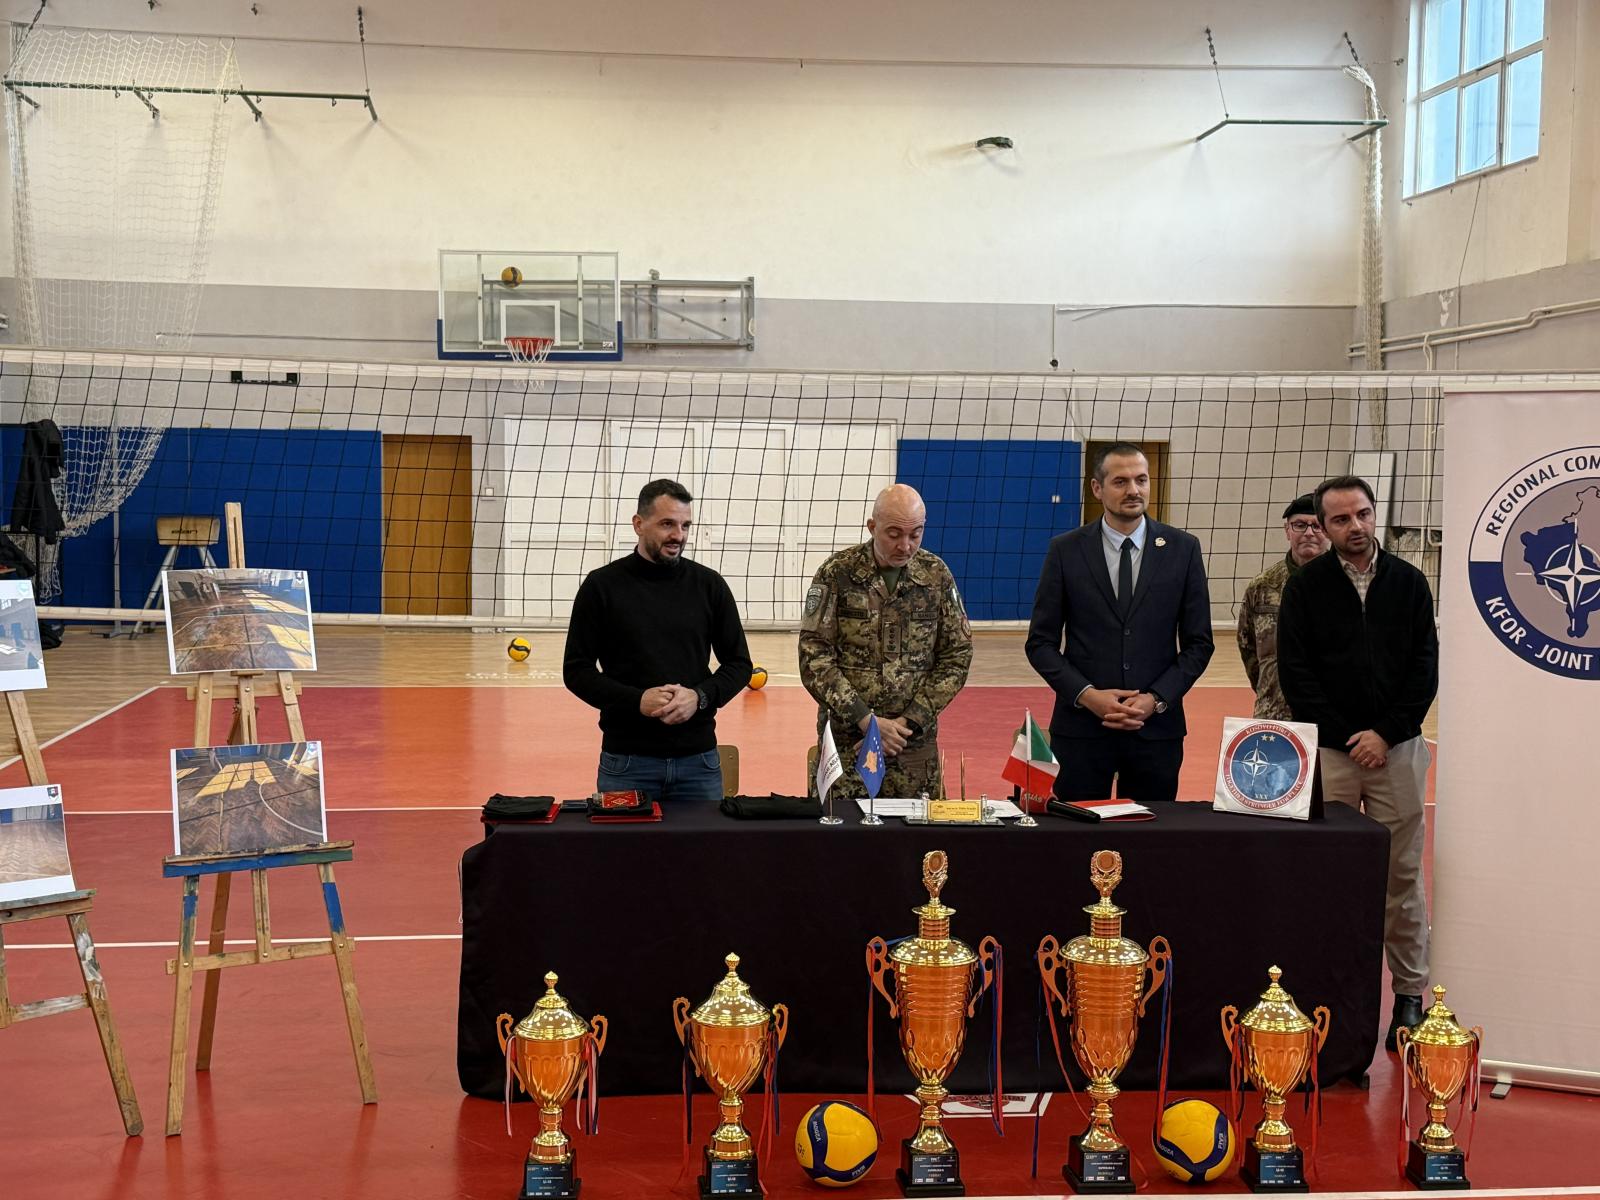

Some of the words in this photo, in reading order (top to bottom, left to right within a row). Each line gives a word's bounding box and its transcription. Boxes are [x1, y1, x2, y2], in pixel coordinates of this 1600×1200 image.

[1485, 463, 1559, 537] REGIONAL
[1485, 596, 1527, 645] KFOR
[1534, 644, 1594, 671] JOINT
